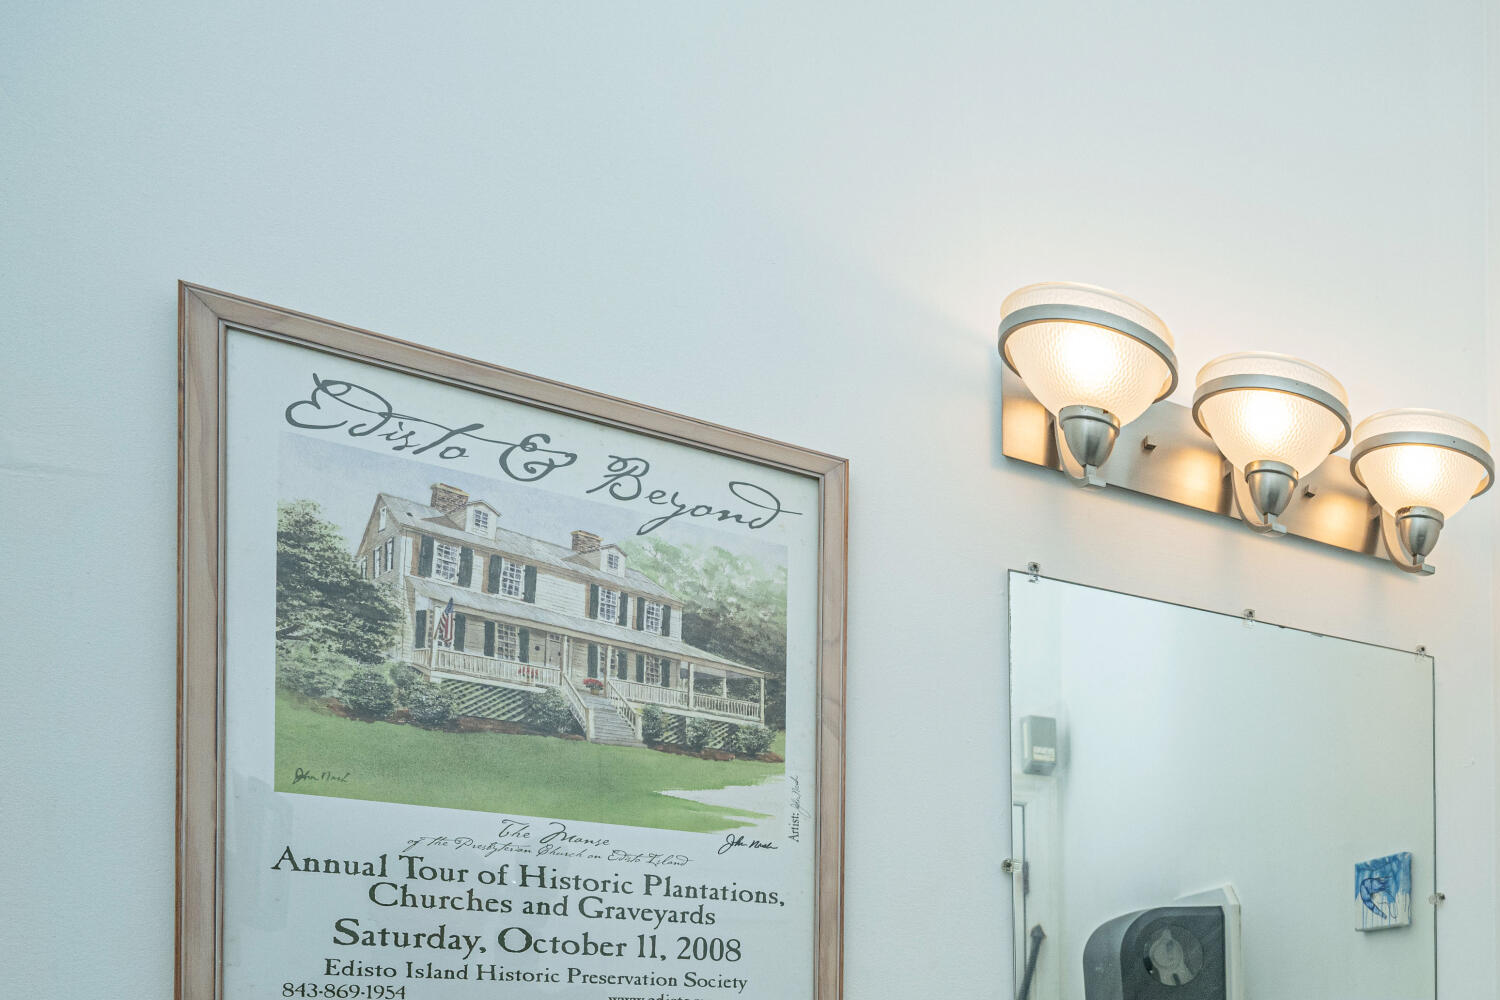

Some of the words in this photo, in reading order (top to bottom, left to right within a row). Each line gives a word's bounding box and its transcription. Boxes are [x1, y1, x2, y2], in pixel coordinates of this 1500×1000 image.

[285, 373, 485, 459] Edisto
[499, 433, 578, 482] &
[586, 455, 802, 535] Beyond
[498, 819, 531, 838] The
[539, 822, 610, 847] Manse
[788, 812, 800, 843] Artist:
[455, 836, 532, 858] Presbyterian
[536, 844, 588, 859] Church
[270, 845, 388, 877] Annual
[398, 854, 469, 883] Tour
[477, 864, 510, 886] of
[519, 864, 634, 894] Historic
[643, 874, 785, 907] Plantations,
[368, 881, 513, 914] Churches
[522, 895, 569, 917] and
[578, 895, 716, 930] Graveyards
[333, 917, 487, 960] Saturday,
[497, 927, 627, 957] October
[637, 934, 667, 961] 11,
[676, 936, 742, 962] 2008
[282, 982, 406, 1000] 843-869-1954
[323, 958, 397, 978] Edisto
[406, 961, 469, 980] Island
[476, 964, 560, 984] Historic
[567, 967, 678, 988] Preservation
[683, 972, 749, 994] Society
